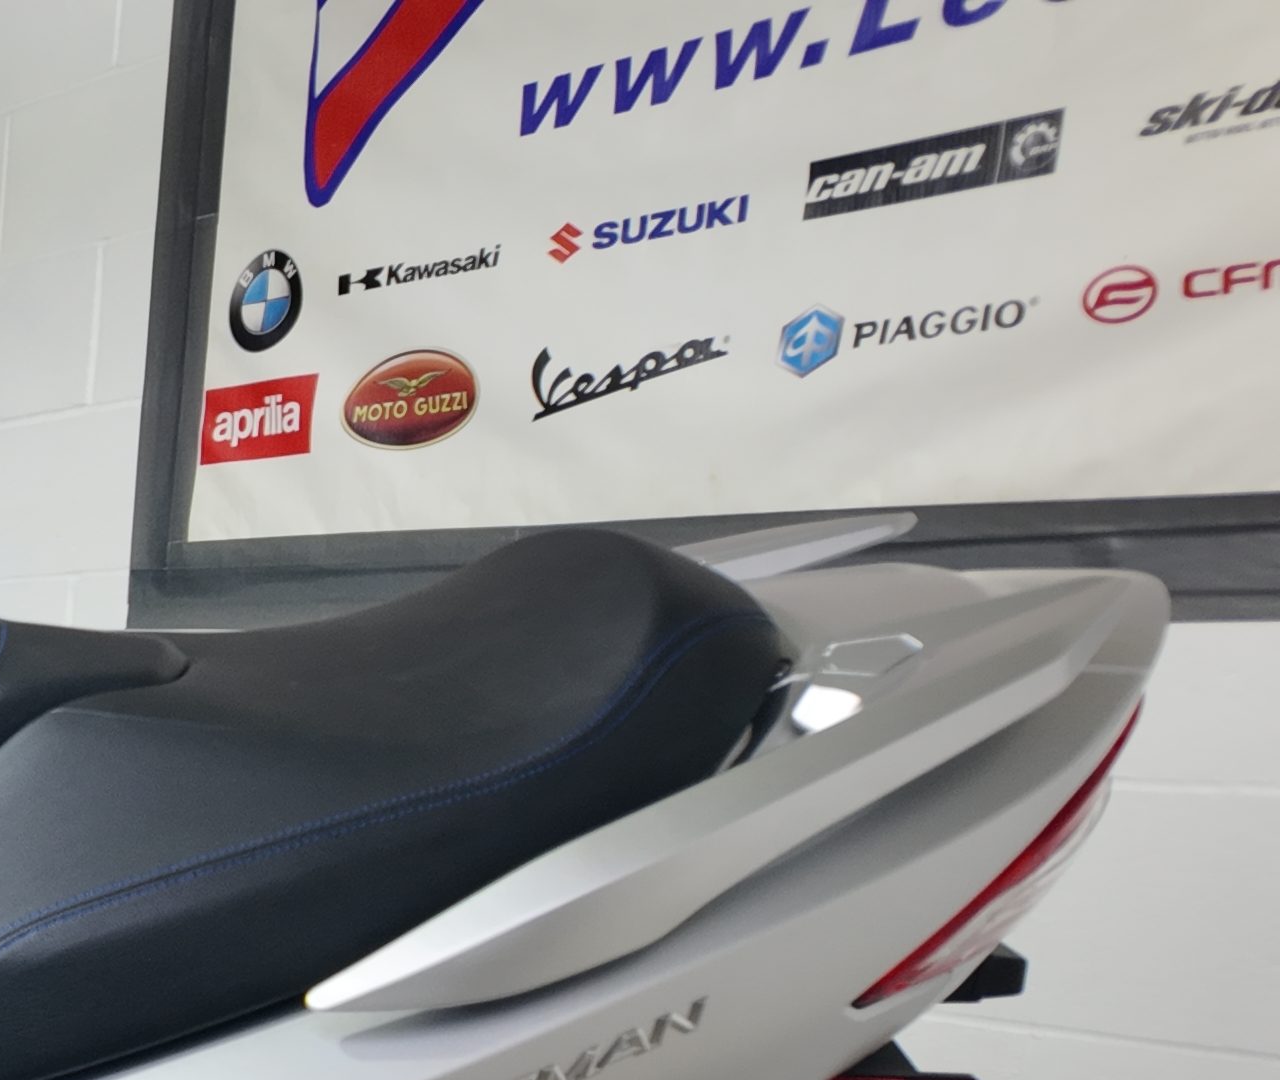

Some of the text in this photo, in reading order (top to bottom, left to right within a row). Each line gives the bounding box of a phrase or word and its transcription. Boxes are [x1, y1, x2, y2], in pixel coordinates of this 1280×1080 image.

[805, 143, 987, 203] can-am
[592, 194, 750, 250] SUZUKI
[239, 251, 297, 288] BMW
[386, 244, 501, 287] Kawasaki
[853, 300, 1027, 348] PIAGGIO
[531, 337, 729, 422] Vespa
[211, 394, 301, 447] aprilia
[352, 391, 469, 423] MOTO GUZZI
